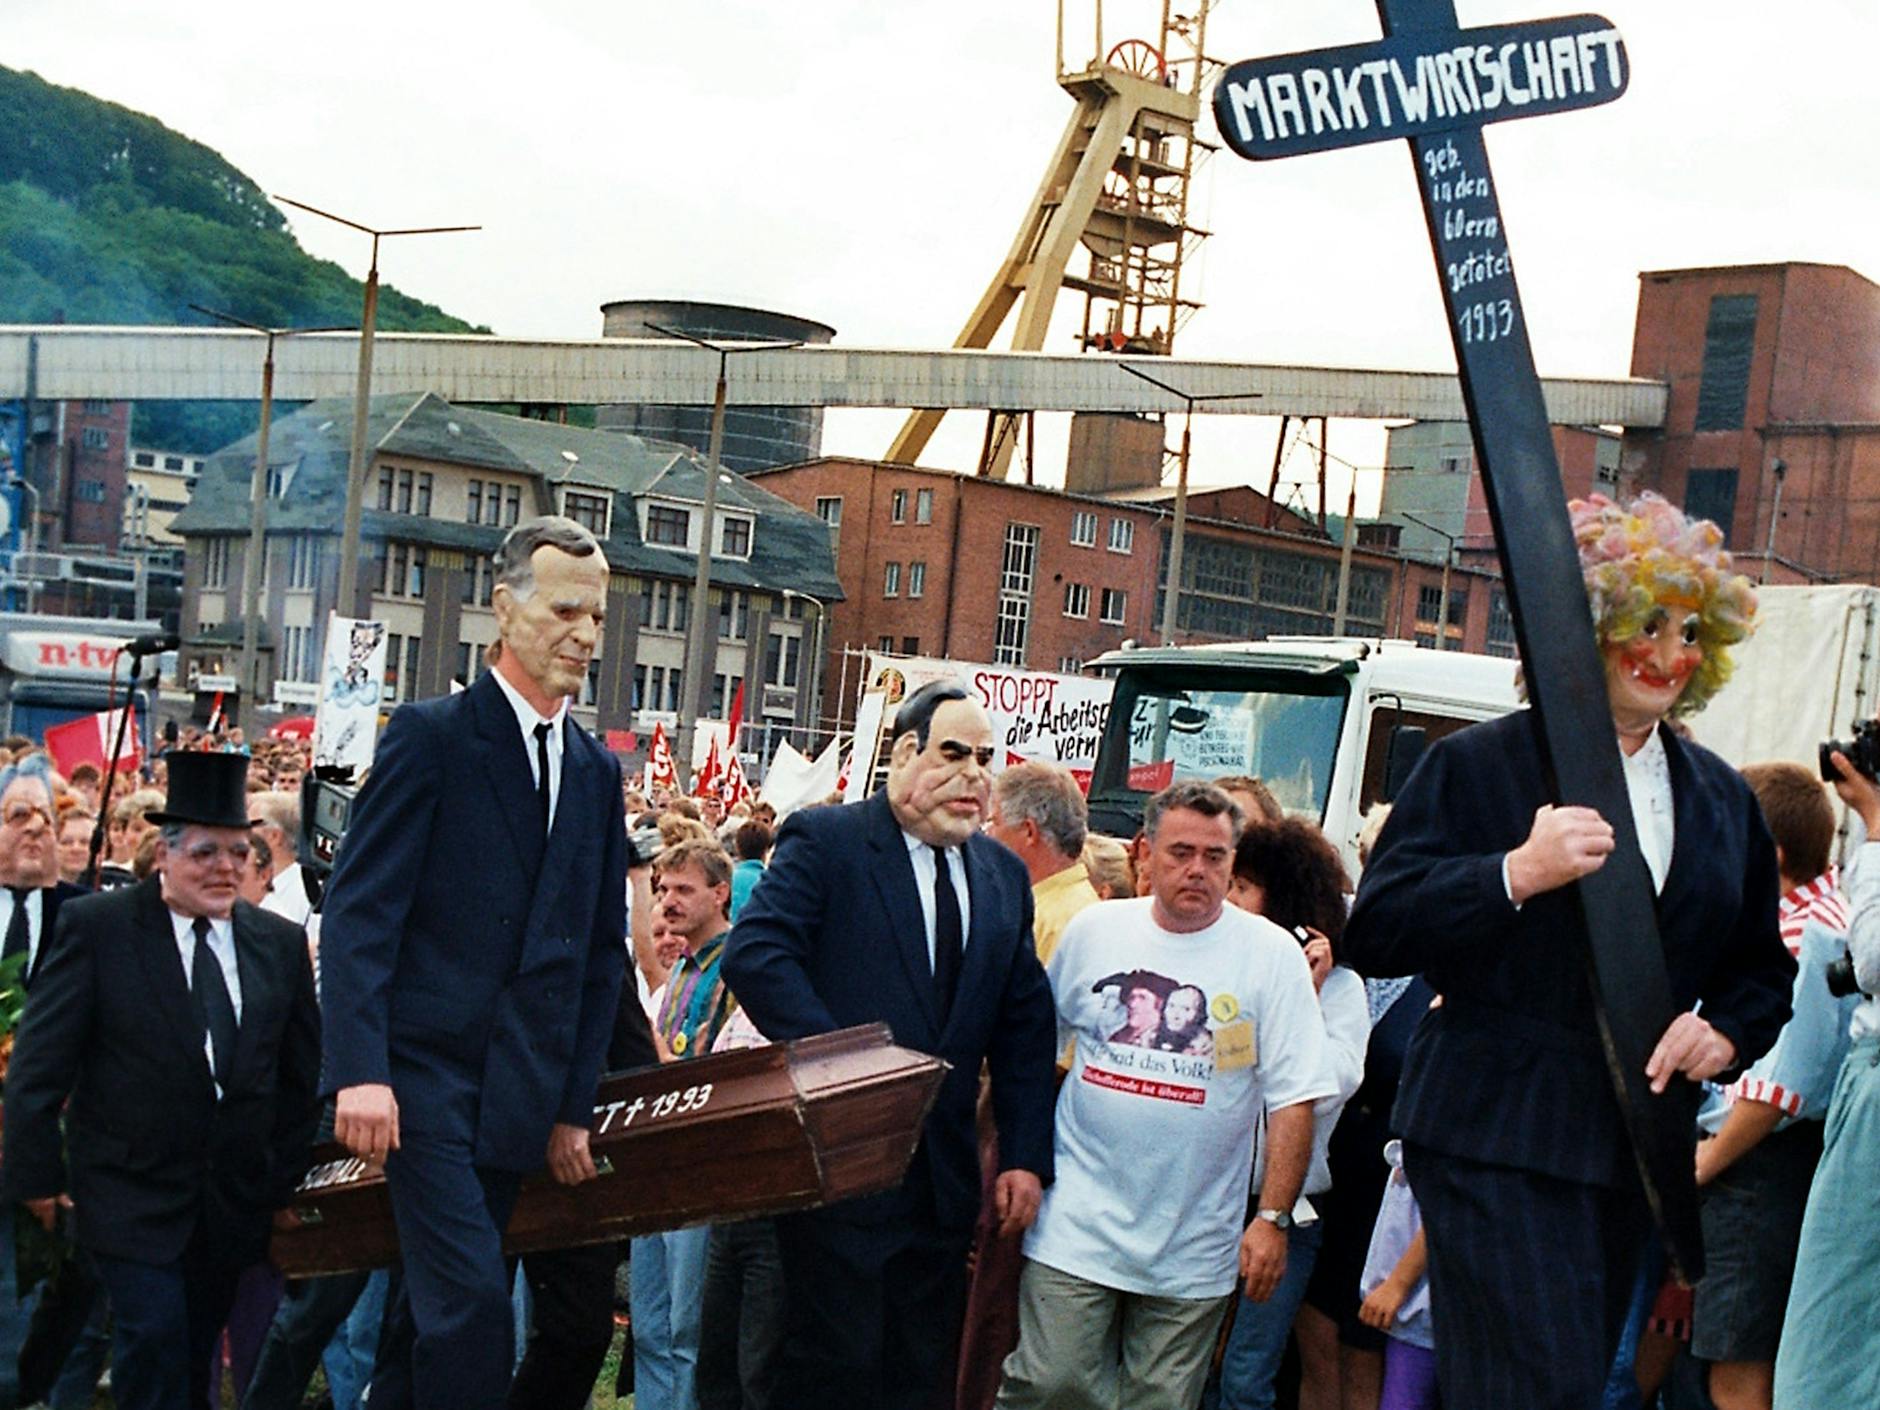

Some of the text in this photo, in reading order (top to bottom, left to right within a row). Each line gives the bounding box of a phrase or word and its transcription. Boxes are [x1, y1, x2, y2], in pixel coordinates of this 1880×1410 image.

[1228, 29, 1622, 142] MARKTWIRTSCHAFT
[1424, 139, 1462, 177] geb.
[1433, 169, 1489, 203] in den
[1448, 248, 1511, 293] getötet
[1459, 299, 1514, 343] 1993
[974, 672, 1059, 715] STOPPT
[1006, 715, 1033, 746] die
[1139, 1054, 1167, 1073] das
[1172, 1058, 1214, 1081] Volk!
[651, 1083, 713, 1118] 1993
